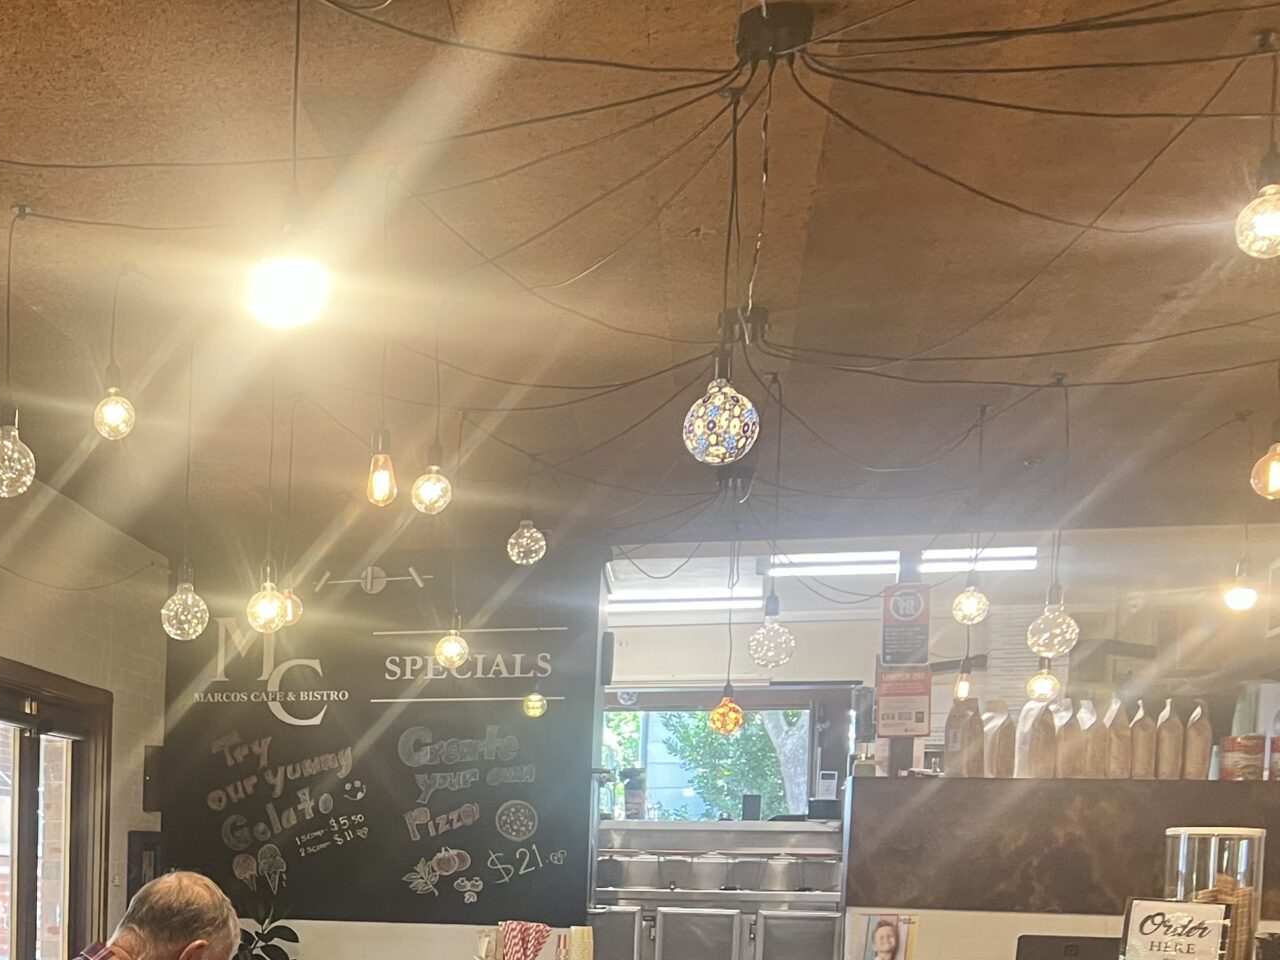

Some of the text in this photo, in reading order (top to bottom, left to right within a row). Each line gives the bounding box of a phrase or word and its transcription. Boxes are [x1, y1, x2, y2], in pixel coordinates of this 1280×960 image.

[385, 653, 552, 680] SPECIALS
[193, 692, 247, 702] MARCOS
[287, 691, 296, 701] &
[300, 690, 349, 701] BISTRO
[210, 729, 272, 769] Try
[397, 724, 519, 767] Create
[207, 747, 353, 811] our yummy
[414, 768, 480, 804] your
[1139, 912, 1212, 938] Order
[1149, 941, 1196, 954] HERE
